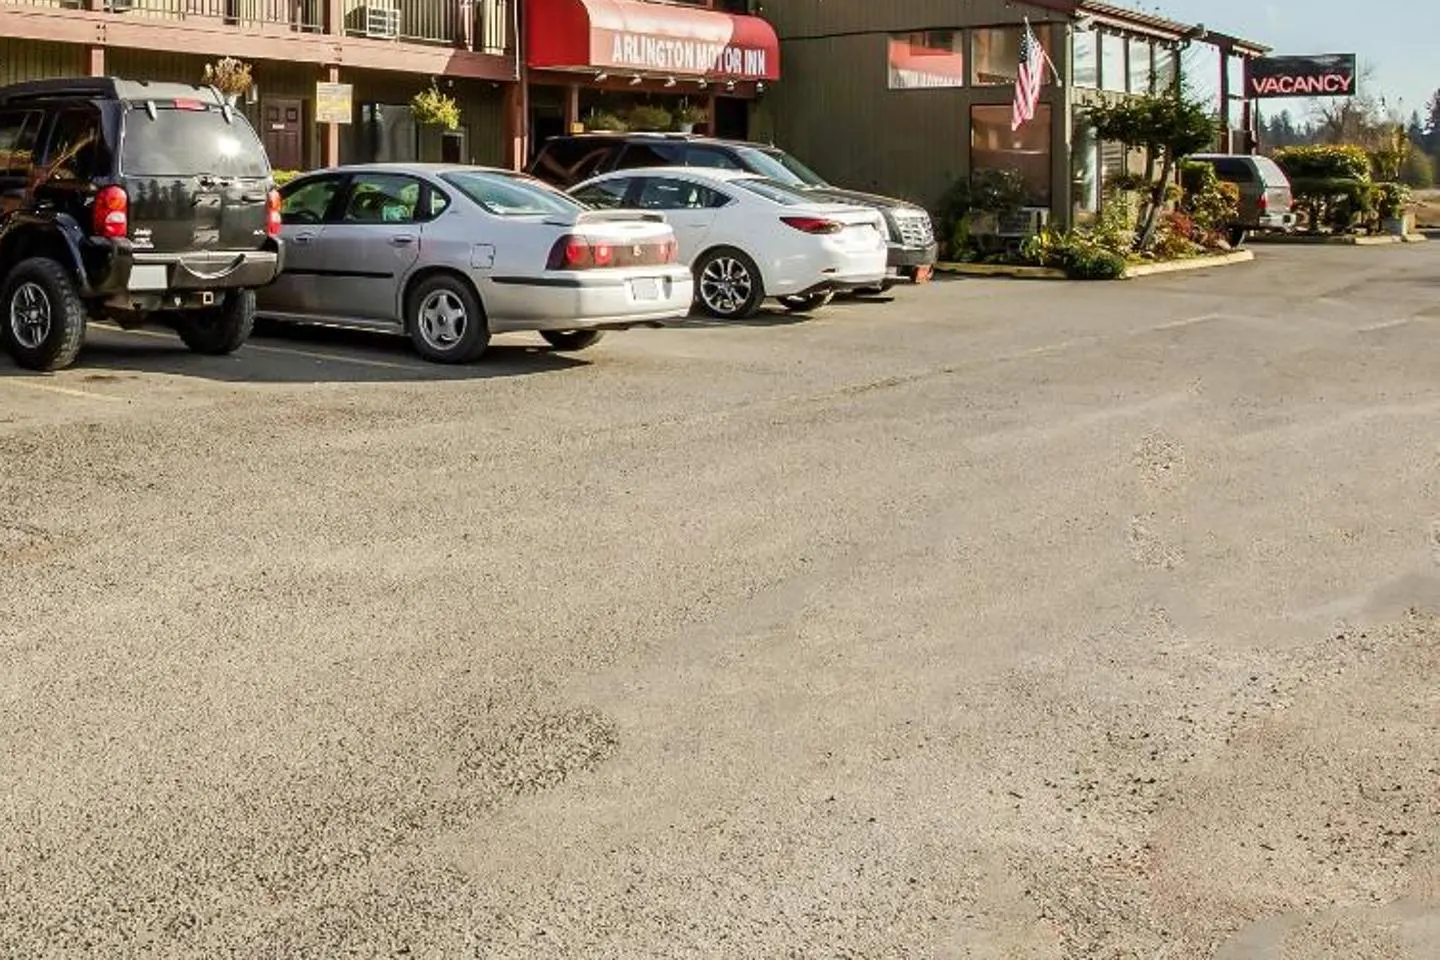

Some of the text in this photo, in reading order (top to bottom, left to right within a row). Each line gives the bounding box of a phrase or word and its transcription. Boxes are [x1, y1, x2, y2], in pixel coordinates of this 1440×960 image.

[612, 33, 766, 75] ARLINGTON MOTOR INN
[1252, 74, 1352, 93] VACANCY
